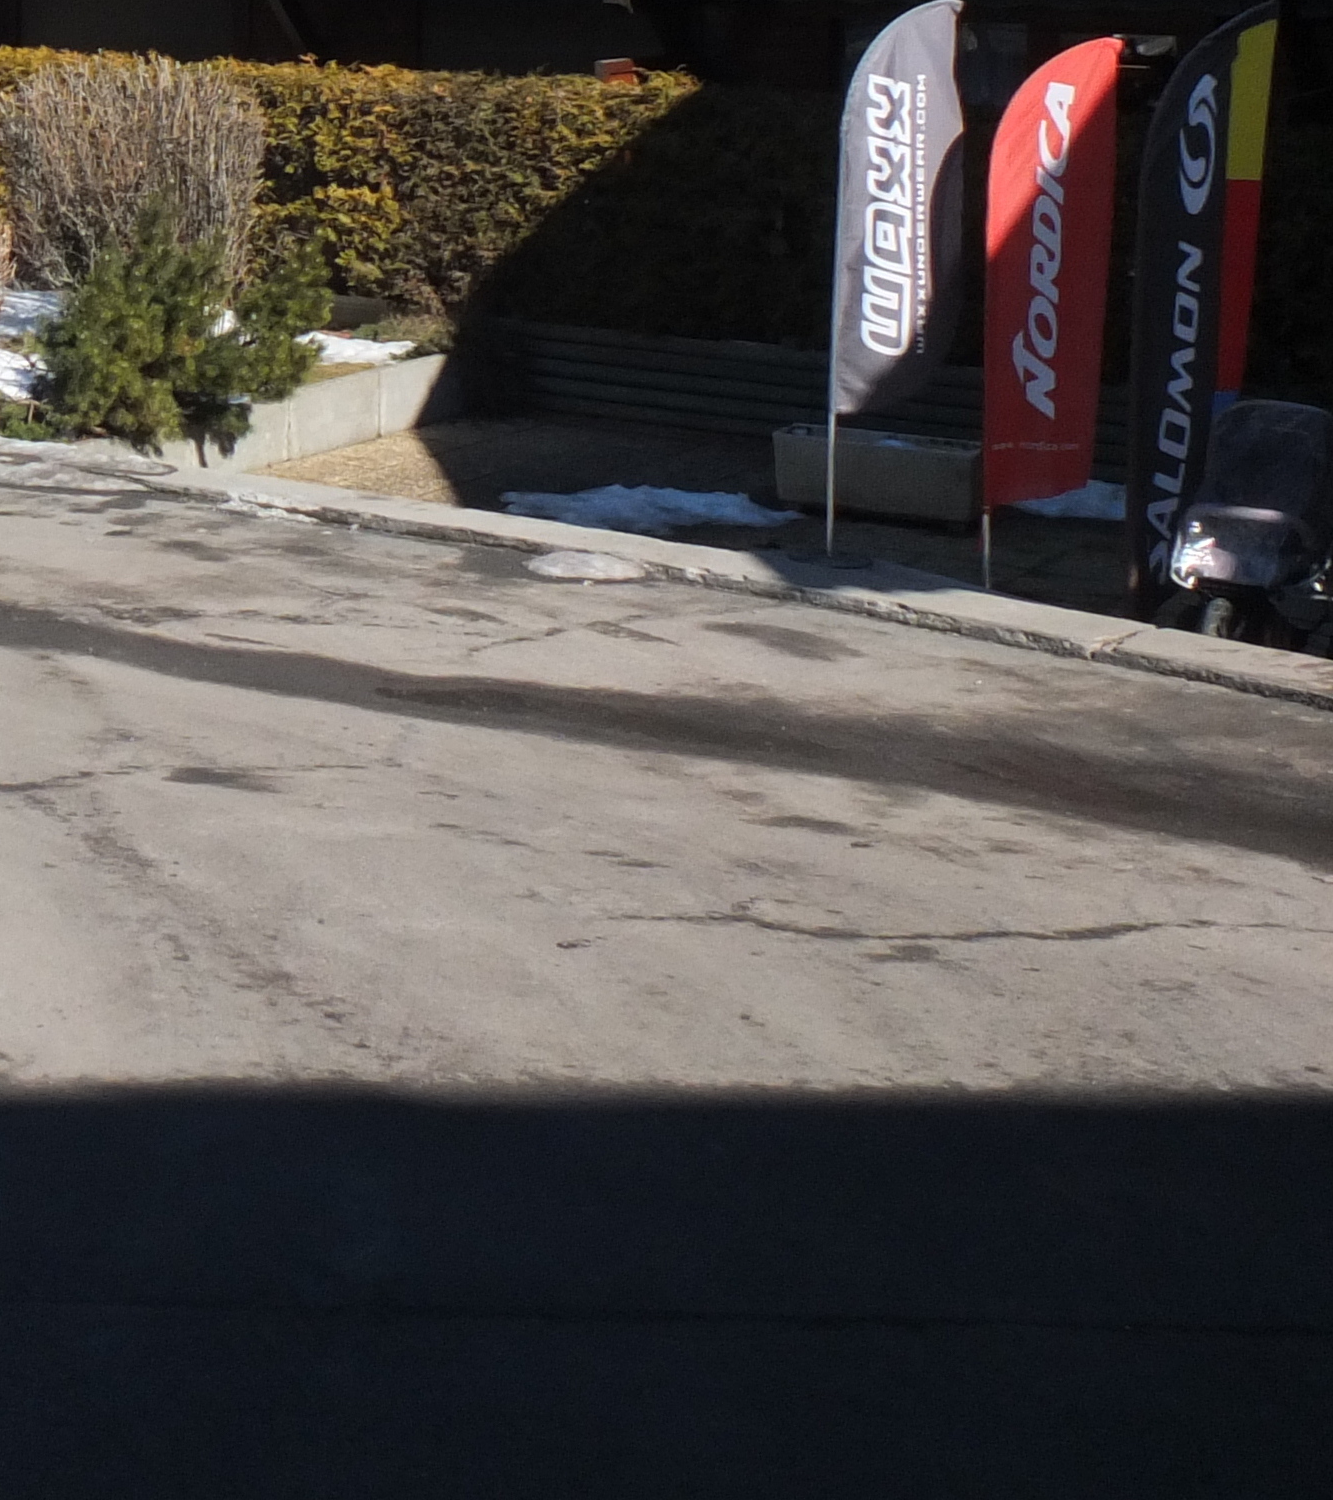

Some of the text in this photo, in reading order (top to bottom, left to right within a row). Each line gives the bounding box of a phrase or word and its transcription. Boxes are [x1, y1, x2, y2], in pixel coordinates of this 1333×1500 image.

[860, 74, 912, 357] WAXX
[1012, 81, 1076, 420] NORDICA
[1146, 240, 1203, 585] SALOMON
